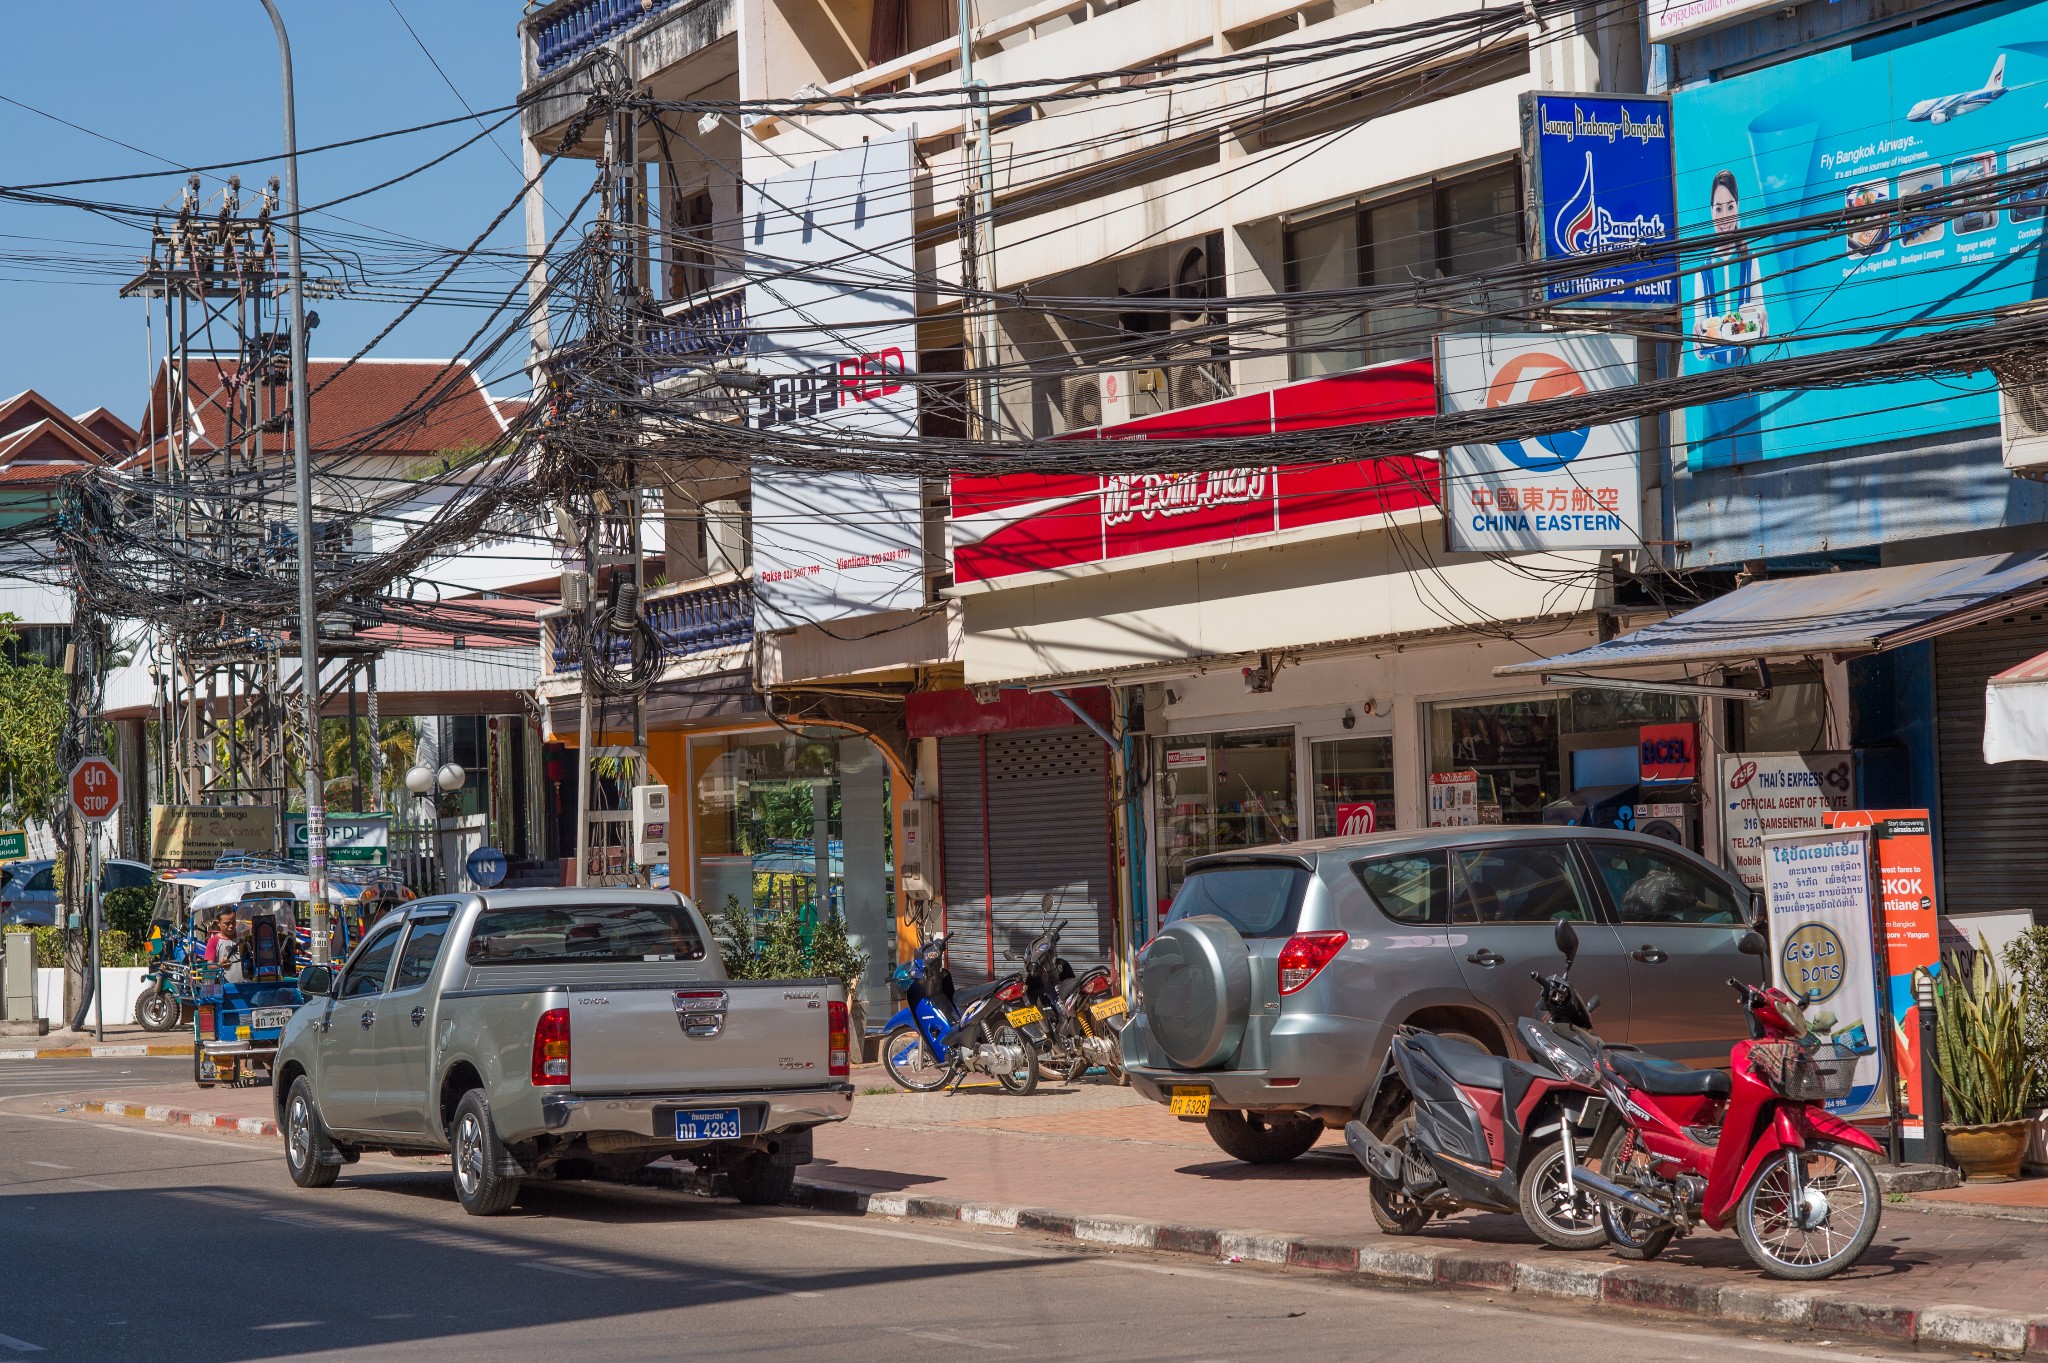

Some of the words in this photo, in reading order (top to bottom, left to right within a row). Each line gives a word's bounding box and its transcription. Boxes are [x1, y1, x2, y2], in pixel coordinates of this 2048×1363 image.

[1541, 103, 1574, 143] Luang
[1820, 154, 1835, 170] Fly
[1836, 143, 1875, 165] Bangkok
[1844, 169, 1852, 177] an
[1853, 166, 1868, 176] entire
[1868, 161, 1890, 173] journey
[1891, 157, 1897, 166] of
[1597, 207, 1666, 244] Bangkok
[1956, 242, 1978, 253] Baggage
[1980, 237, 1997, 248] weight
[1882, 258, 1897, 270] Meals
[1900, 252, 1922, 265] Boutique
[1923, 249, 1945, 261] Lounges
[1968, 251, 1995, 263] kilograms
[1553, 277, 1625, 295] AUTHORIZED
[1635, 278, 1672, 296] AGENT
[1471, 486, 1619, 512] 中國東方航空
[1473, 515, 1530, 532] CHINA
[1536, 514, 1620, 531] EASTERN
[837, 555, 870, 571] Vientiane
[762, 570, 782, 584] Pakse
[1641, 739, 1691, 765] BCEL
[84, 766, 107, 793] ຢຸດ
[1732, 762, 1755, 788] TSE
[1787, 772, 1823, 788] EXPRESS
[83, 796, 109, 811] STOP
[1740, 798, 1776, 810] OFFICIAL
[1778, 797, 1806, 809] AGENT
[1807, 796, 1818, 808] OF
[1819, 796, 1830, 808] TG
[1833, 796, 1847, 808] VTE
[209, 821, 265, 837] Restaurant
[1743, 818, 1758, 830] 316
[1760, 817, 1817, 830] SAMSENETHAI
[477, 860, 496, 873] IN
[1737, 855, 1761, 866] Mobile
[255, 880, 277, 890] 2016
[1893, 920, 1916, 928] Bangkok
[1801, 964, 1841, 983] DOTS
[577, 997, 610, 1006] TOYOTA
[679, 1123, 697, 1138] ກກ
[703, 1121, 737, 1138] 4283
